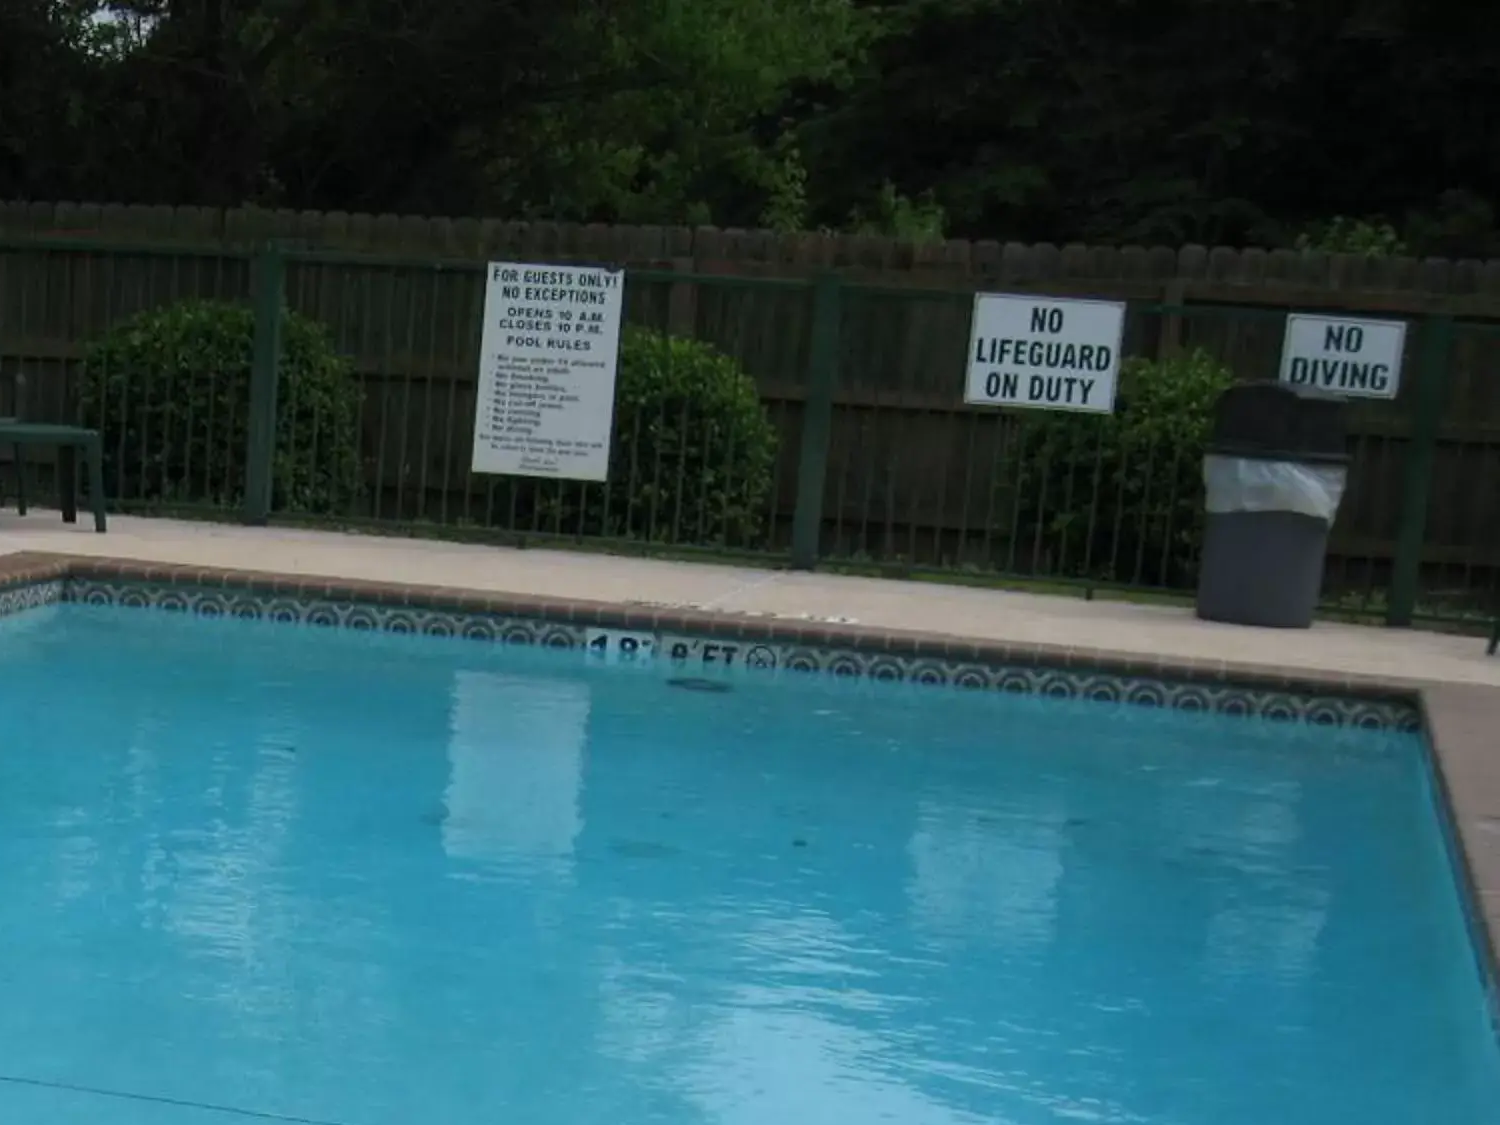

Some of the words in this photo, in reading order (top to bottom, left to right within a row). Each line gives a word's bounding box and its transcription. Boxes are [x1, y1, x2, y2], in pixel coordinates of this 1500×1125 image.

[494, 266, 519, 282] FOR
[523, 270, 573, 286] GUESTS
[502, 285, 520, 300] NO
[525, 287, 605, 305] EXCEPTIONS
[507, 307, 553, 319] OPENS
[559, 310, 573, 321] 10
[1030, 307, 1064, 333] NO
[499, 319, 553, 331] CLOSES
[558, 322, 571, 333] 10
[506, 335, 542, 349] POOL
[547, 338, 592, 351] RULES
[1324, 325, 1364, 353] NO
[976, 337, 1111, 371] LIFEGUARD
[1290, 356, 1389, 390] DIVING
[986, 372, 1019, 398] ON
[1029, 374, 1094, 404] DUTY
